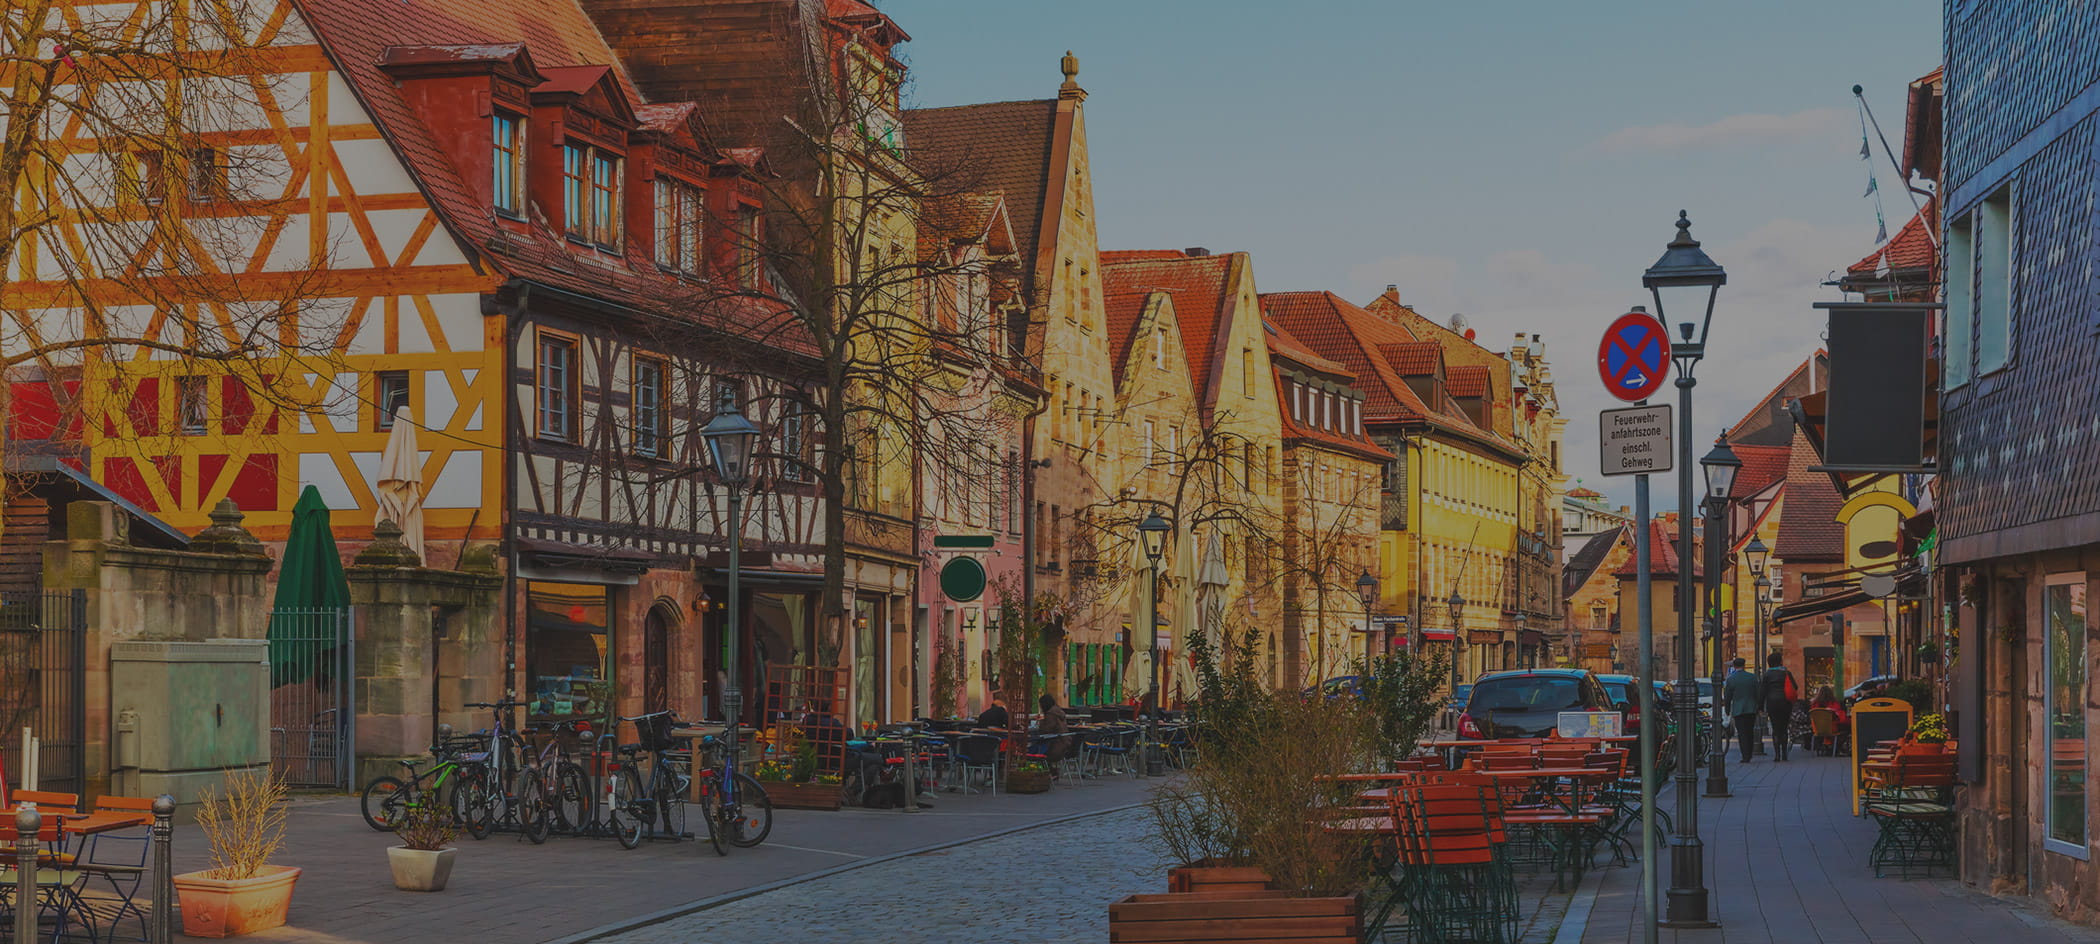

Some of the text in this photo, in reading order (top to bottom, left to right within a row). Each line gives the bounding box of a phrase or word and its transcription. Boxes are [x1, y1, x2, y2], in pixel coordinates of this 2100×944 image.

[1614, 413, 1660, 426] Feuerwehr-
[1611, 426, 1661, 439] anfahrtszone
[1622, 441, 1652, 454] einschl.
[1622, 457, 1653, 468] Gehweg
